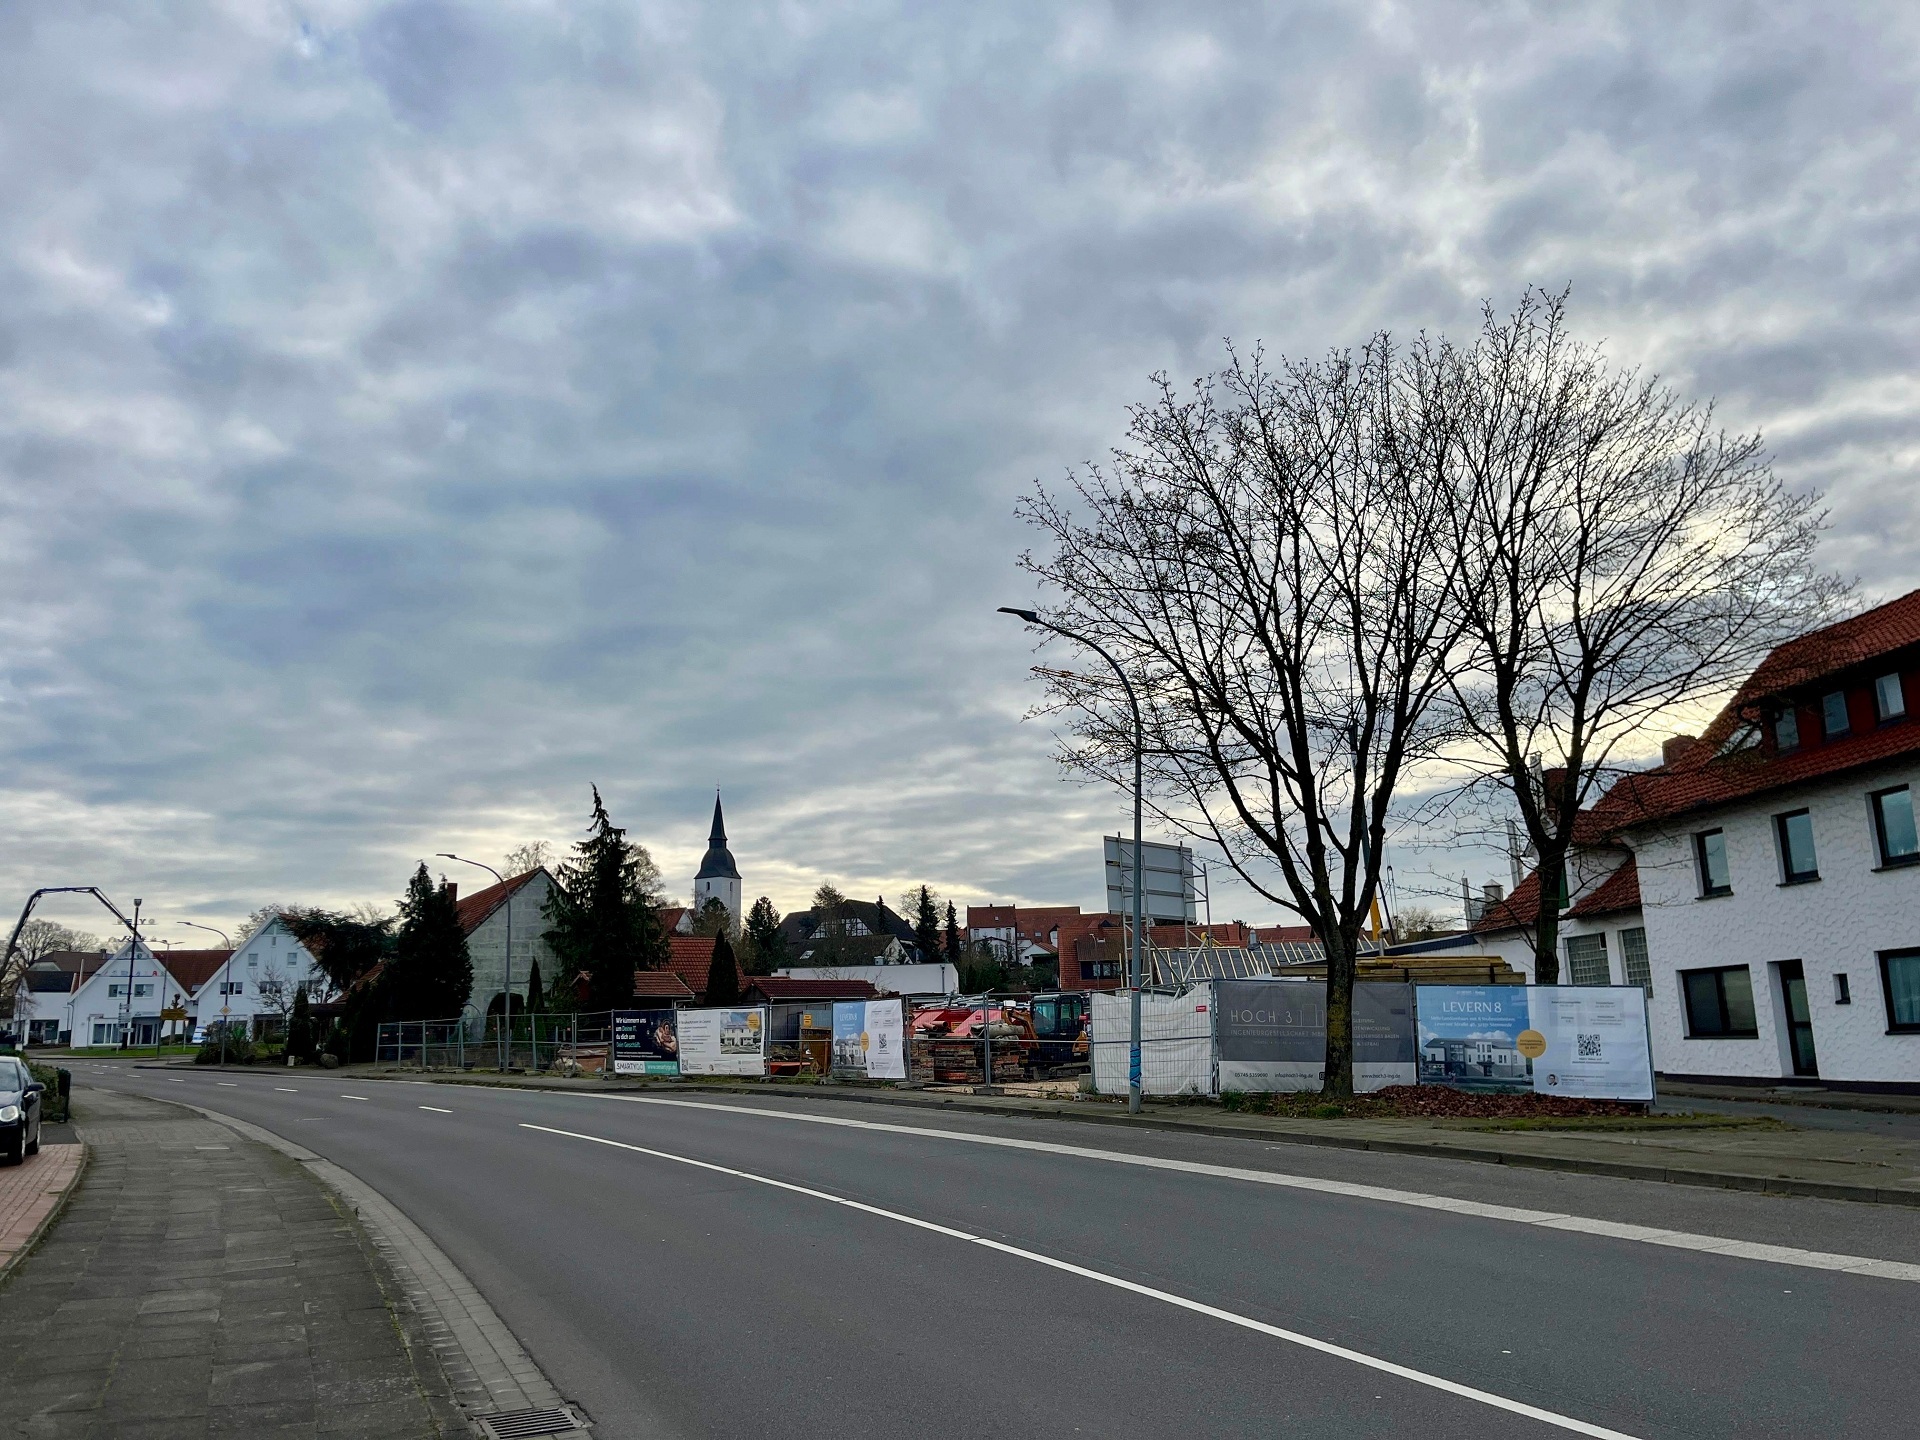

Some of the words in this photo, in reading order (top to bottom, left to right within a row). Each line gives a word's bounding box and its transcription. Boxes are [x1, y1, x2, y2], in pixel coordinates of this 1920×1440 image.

[1443, 1002, 1492, 1012] LEVERN
[1494, 1002, 1502, 1013] 8
[1231, 1009, 1276, 1023] HOCH
[1285, 1010, 1293, 1024] 3
[1231, 1029, 1309, 1037] INGENIEURGESELLSCHAFT
[616, 1063, 643, 1071] SMARTYGO
